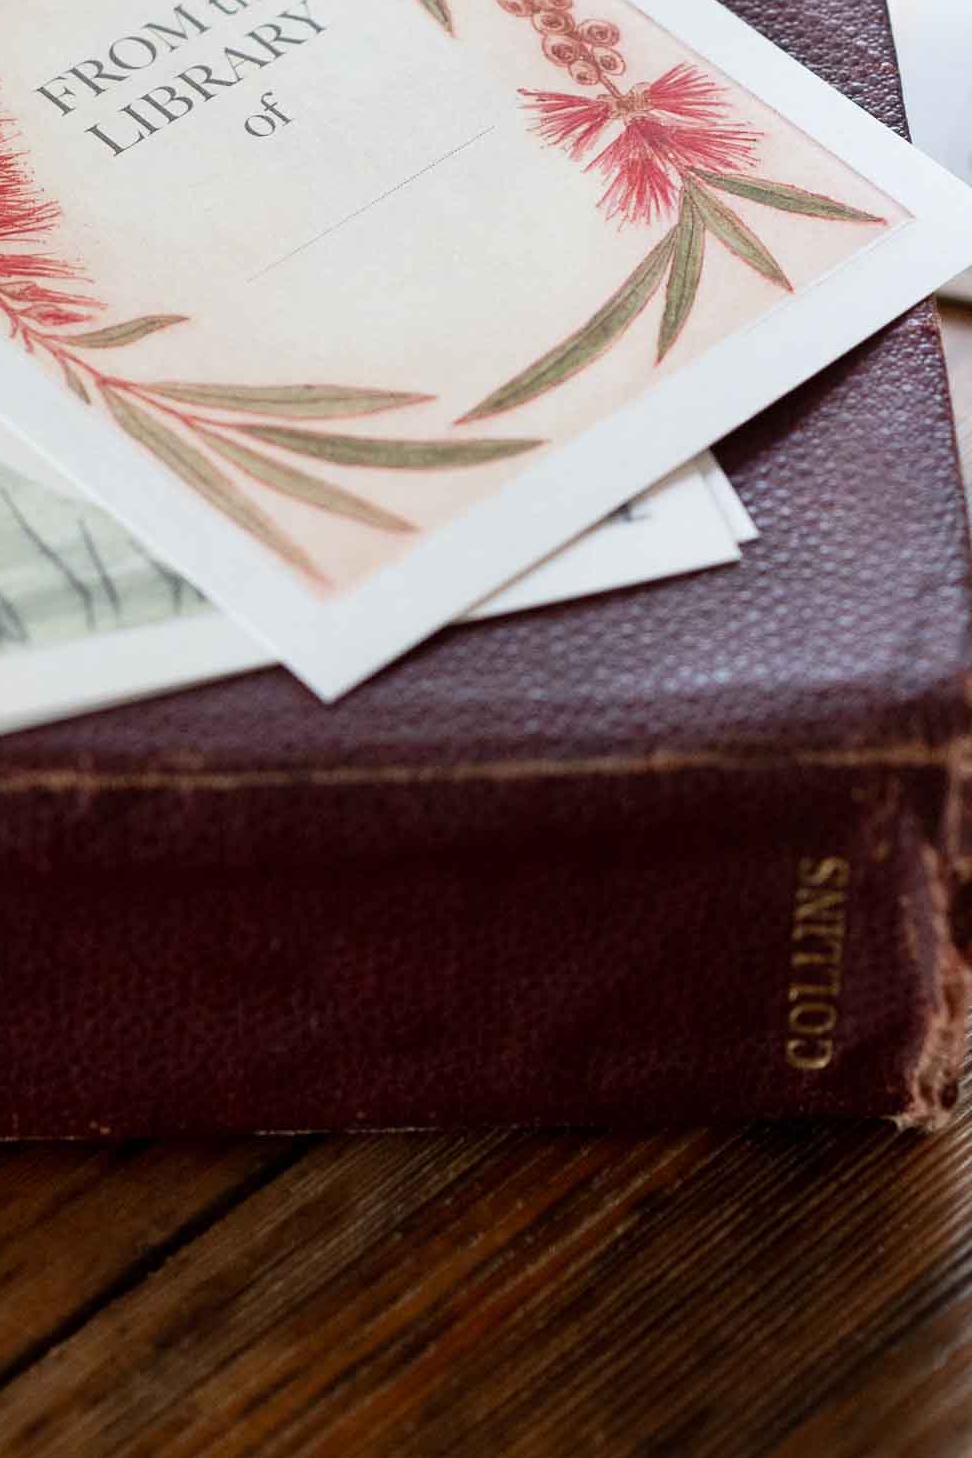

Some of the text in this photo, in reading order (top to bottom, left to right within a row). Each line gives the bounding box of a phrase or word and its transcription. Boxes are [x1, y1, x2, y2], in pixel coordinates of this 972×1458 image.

[32, 3, 212, 117] FROM
[243, 90, 296, 138] of
[786, 856, 850, 1070] COLLINS
